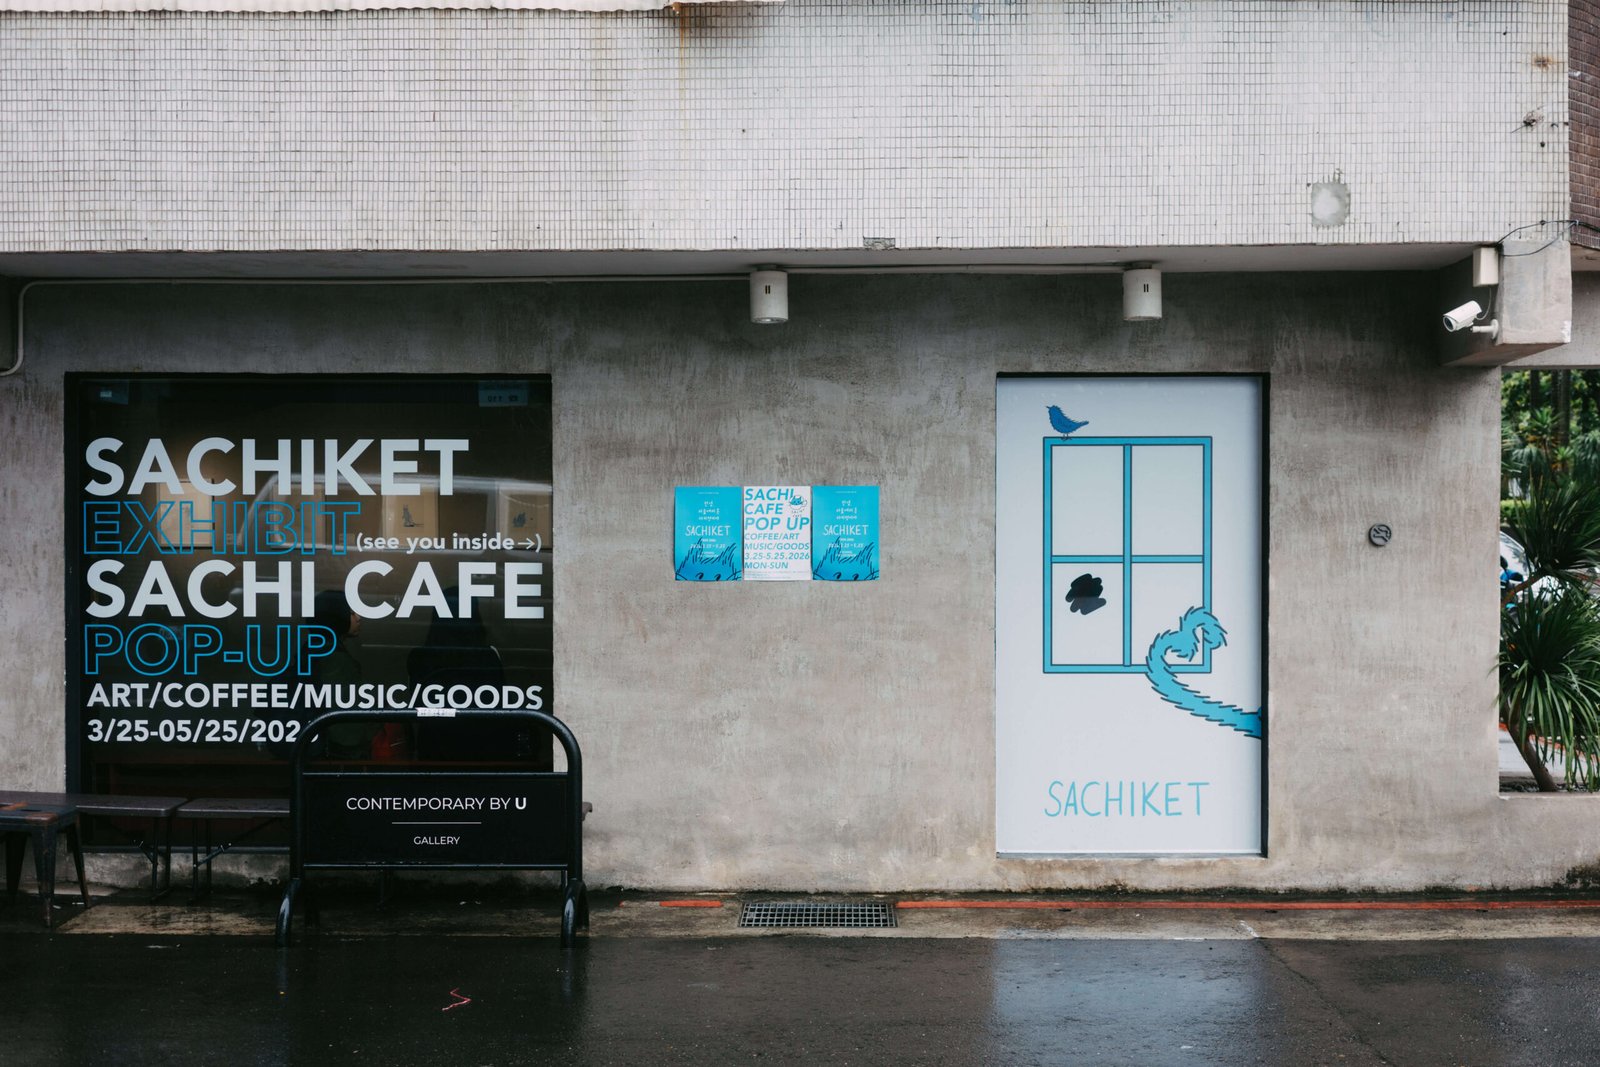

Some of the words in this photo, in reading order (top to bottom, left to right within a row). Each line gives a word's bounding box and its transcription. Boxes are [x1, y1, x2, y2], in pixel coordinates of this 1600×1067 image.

[84, 437, 470, 496] SACHIKET
[744, 488, 794, 501] SACHI
[744, 503, 784, 515] CAFE
[83, 501, 361, 555] EXHIBIT
[356, 532, 400, 552] (see
[406, 537, 446, 554] you
[745, 517, 782, 531] POP
[786, 517, 810, 531] UP
[823, 524, 869, 536] SACHIKET
[685, 525, 731, 537] SACHIKET
[744, 533, 800, 541] COFFEE/ART
[744, 542, 810, 551] MUSIC/GOODS
[744, 552, 810, 561] 3.25-5.25.2026
[744, 562, 789, 570] MON-SUN
[85, 560, 315, 619] SACHI
[344, 560, 545, 619] CAFE
[84, 623, 337, 677] POP-UP
[86, 682, 543, 710] ART/COFFEE/MUSIC/GOODS
[87, 718, 319, 743] 3/25-05/25/202
[346, 797, 486, 811] CONTEMPORARY
[489, 797, 511, 811] BY
[515, 797, 527, 811] U
[1044, 780, 1210, 817] SACHIKET
[413, 836, 461, 846] GALLERY
